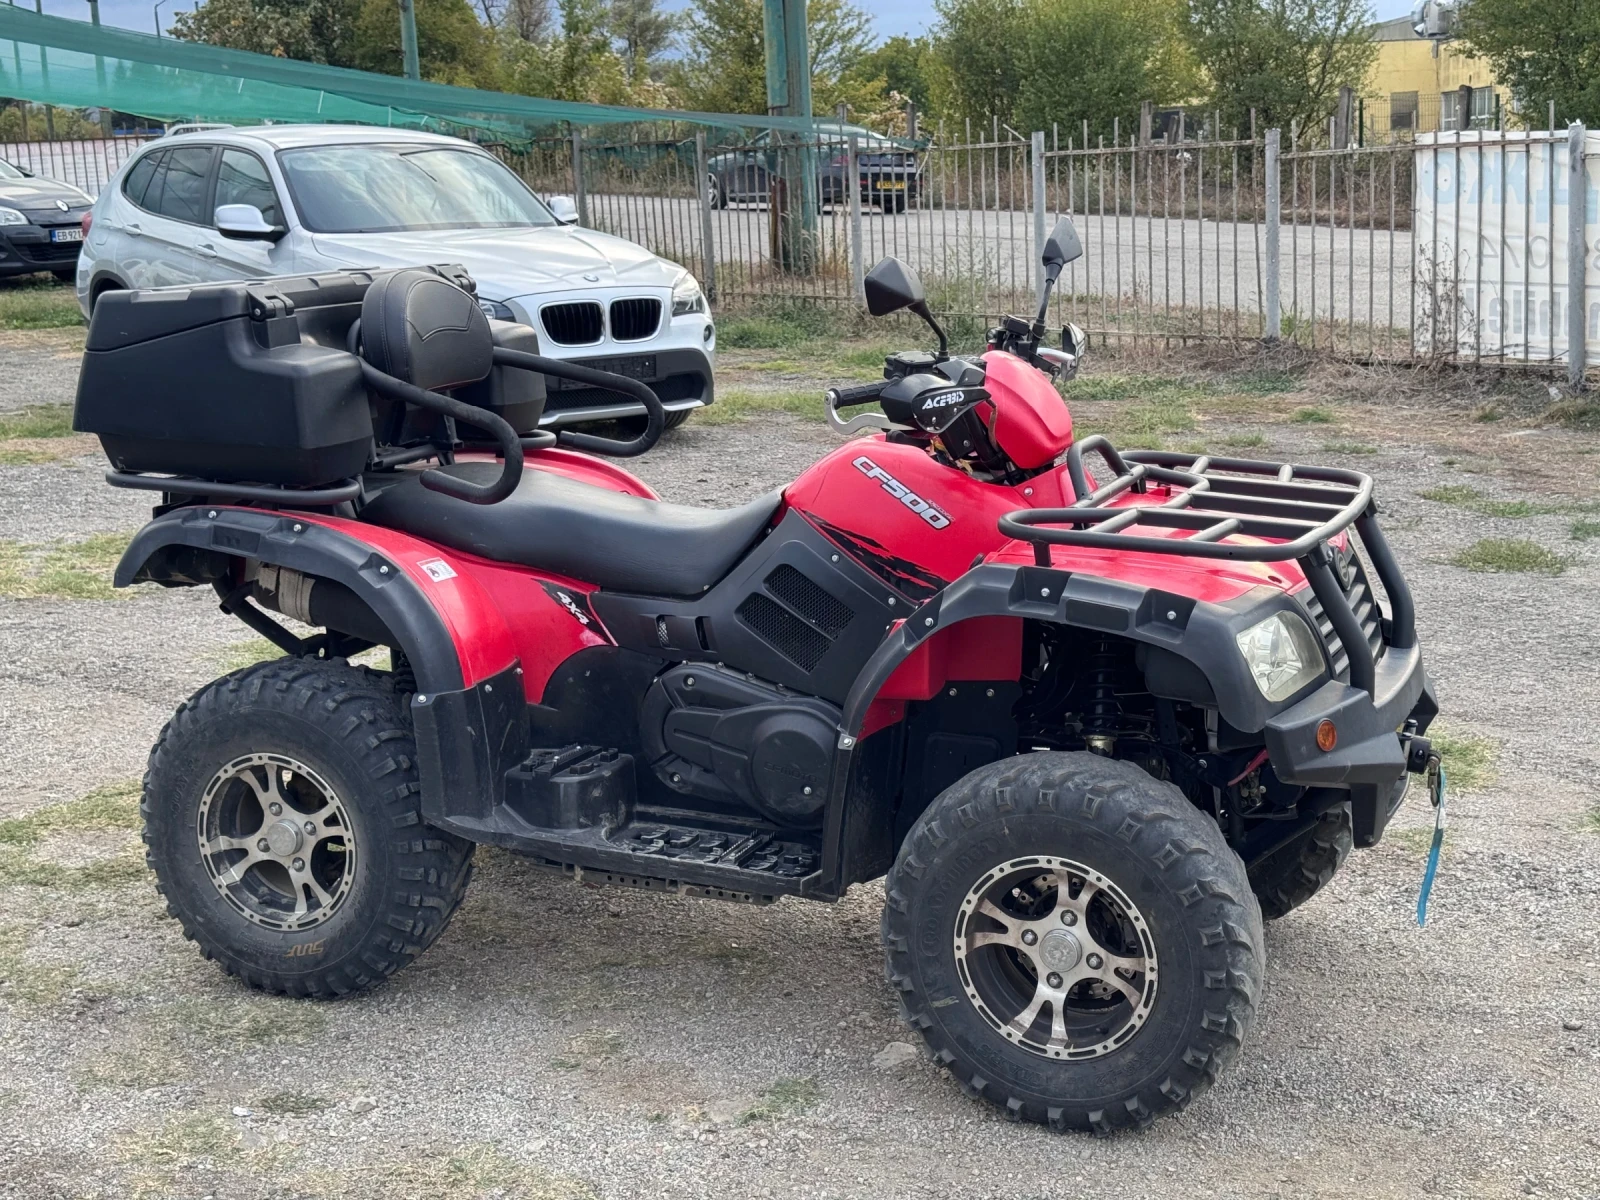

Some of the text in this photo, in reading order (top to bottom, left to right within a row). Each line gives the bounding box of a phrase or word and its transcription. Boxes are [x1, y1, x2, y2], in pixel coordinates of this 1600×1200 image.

[57, 231, 67, 240] EB
[922, 390, 965, 410] ACERBIS
[851, 456, 952, 530] CF500
